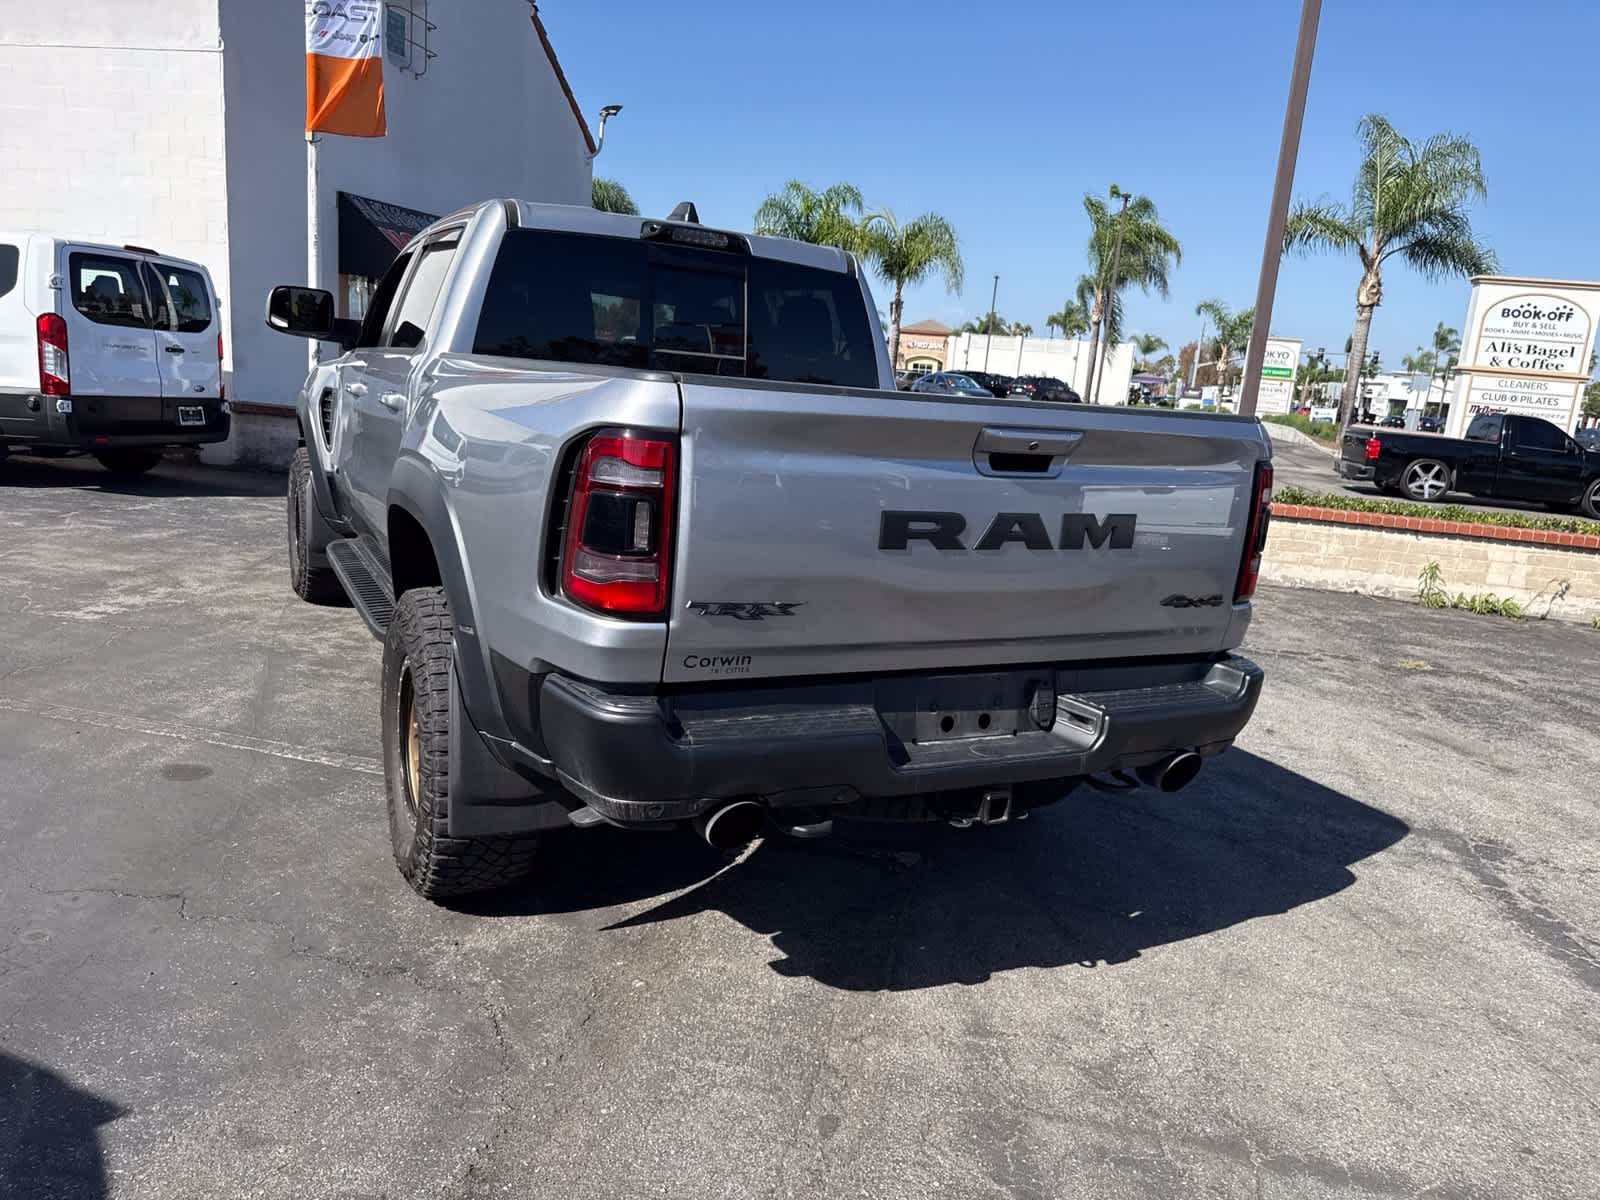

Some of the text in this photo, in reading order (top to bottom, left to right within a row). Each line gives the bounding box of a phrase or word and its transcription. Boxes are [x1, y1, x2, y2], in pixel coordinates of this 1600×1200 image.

[1539, 322, 1557, 330] SELL
[1525, 344, 1576, 359] Bagel
[1489, 355, 1565, 371] & Coffee
[1497, 379, 1549, 391] CLEANERS
[1481, 392, 1508, 402] CLUB
[1519, 397, 1560, 407] PILATES
[878, 510, 1138, 550] RAM
[683, 654, 752, 668] Corwin
